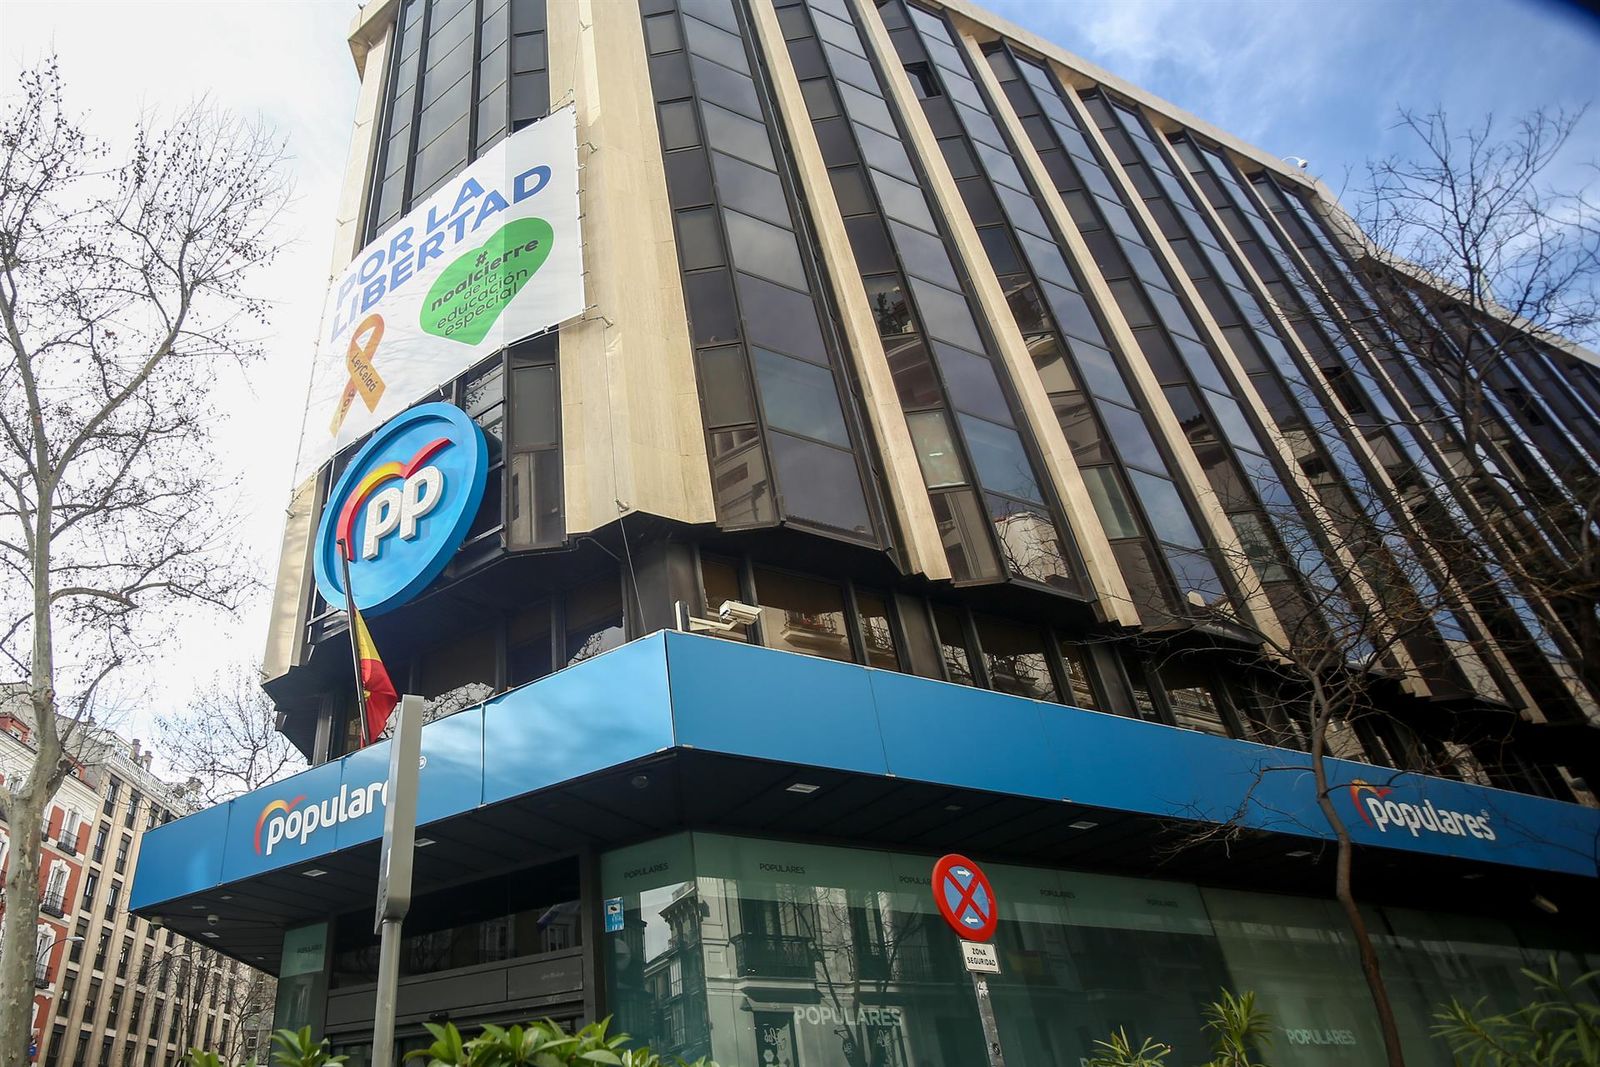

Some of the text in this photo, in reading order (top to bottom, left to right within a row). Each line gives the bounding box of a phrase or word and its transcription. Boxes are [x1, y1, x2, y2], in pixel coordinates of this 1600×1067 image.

[331, 165, 552, 344] LIBERTAD
[336, 176, 486, 304] POR LA
[431, 240, 539, 312] noalcierre
[463, 272, 497, 300] de la
[437, 268, 528, 329] educación
[445, 283, 517, 336] especial
[266, 779, 390, 856] popular
[1366, 797, 1496, 841] populares
[760, 863, 806, 873] POPULARES
[966, 957, 996, 967] SEGURIDAD
[971, 947, 987, 956] ZONA
[793, 1006, 902, 1026] POPULARES
[1286, 1029, 1356, 1045] POPULARES
